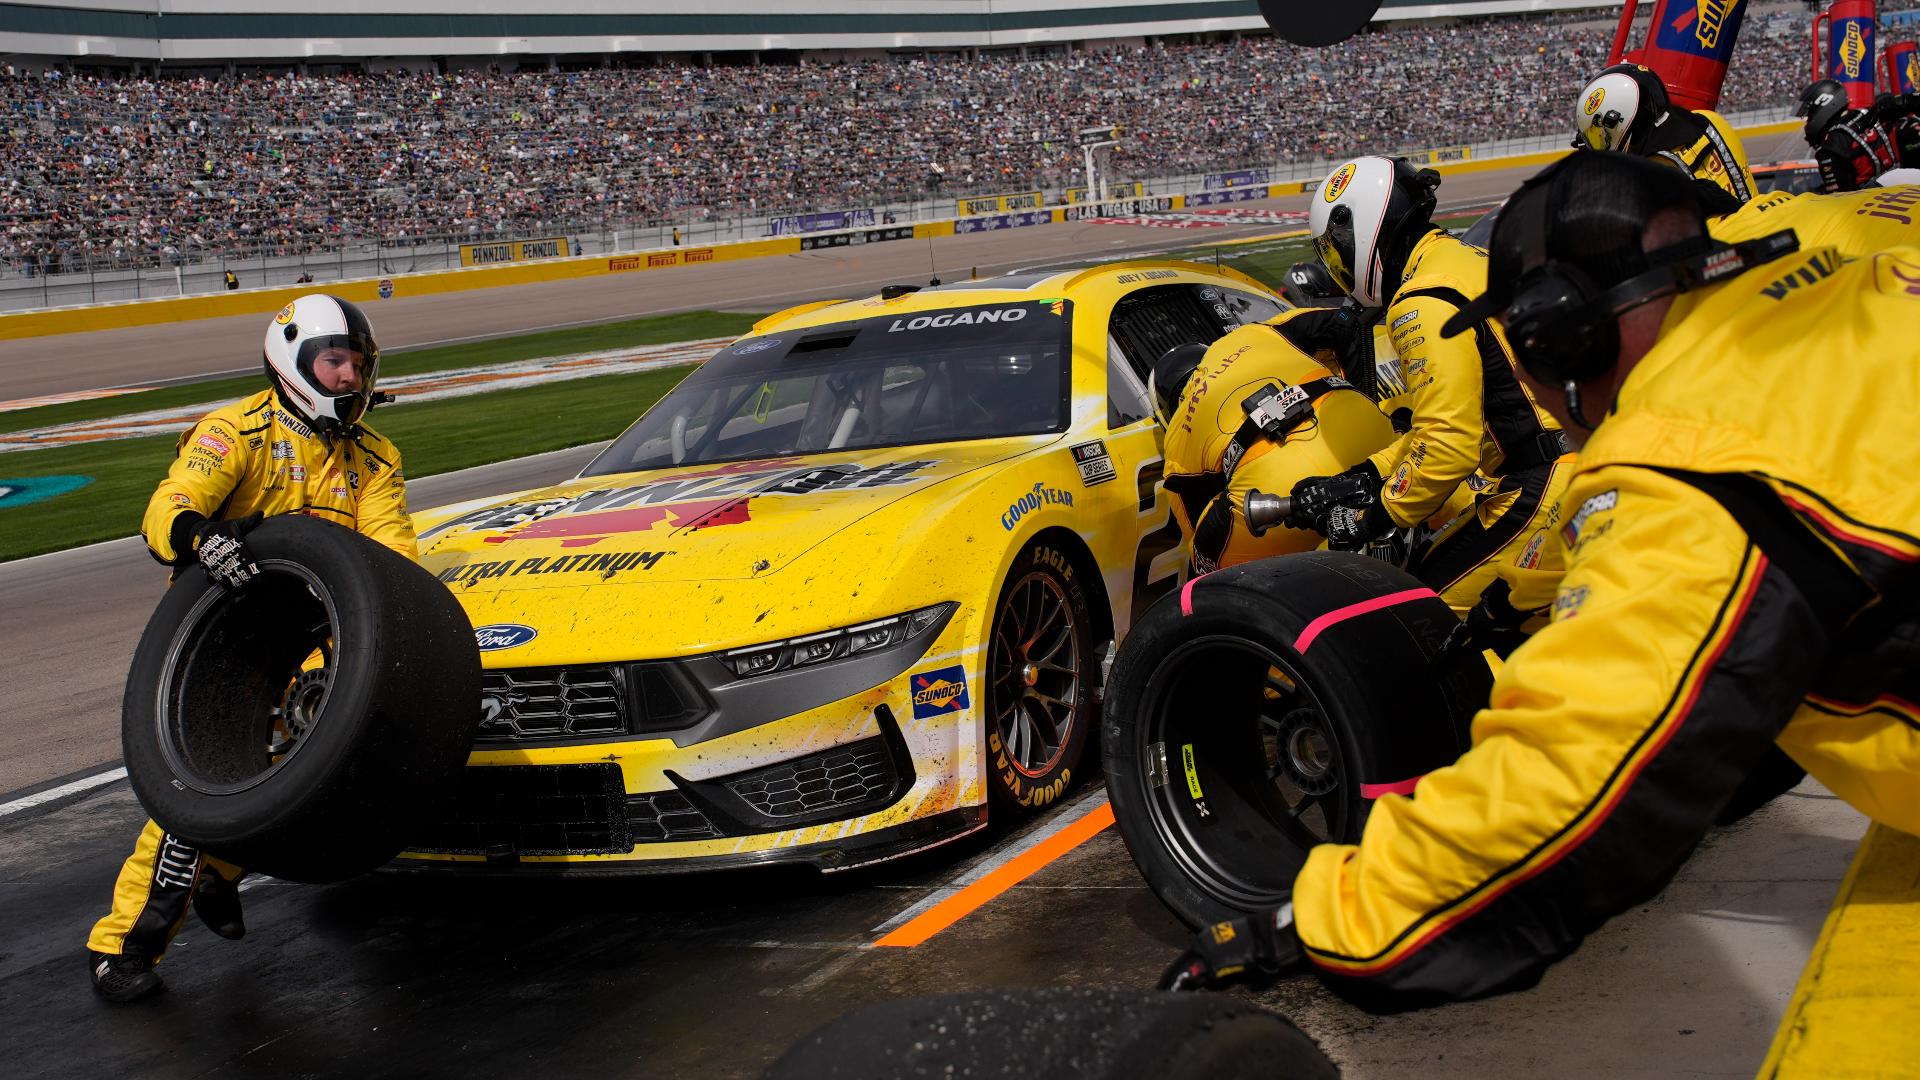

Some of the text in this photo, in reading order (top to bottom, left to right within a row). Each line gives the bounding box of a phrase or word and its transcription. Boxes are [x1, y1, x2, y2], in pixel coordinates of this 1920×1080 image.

[1847, 24, 1859, 76] SUNOCO
[1330, 167, 1349, 197] PENNZOIL
[1078, 199, 1159, 219] LAS VEGAS USA
[472, 241, 560, 264] PENNZOIL PENNZOIL
[609, 249, 713, 271] PIRELLI PIRELLI PIRELLI
[1117, 270, 1179, 285] JOEY LOGANO
[887, 307, 1028, 334] LOGANO
[1208, 345, 1252, 379] lube
[275, 409, 314, 440] PENNZOIL
[191, 446, 224, 465] Mazak
[1001, 482, 1074, 532] GOODYEAR
[438, 560, 517, 583] ULTRA
[1032, 546, 1074, 582] EAGLE
[474, 627, 520, 647] Ford
[916, 683, 963, 704] SUNOCO
[1189, 776, 1198, 793] RACE
